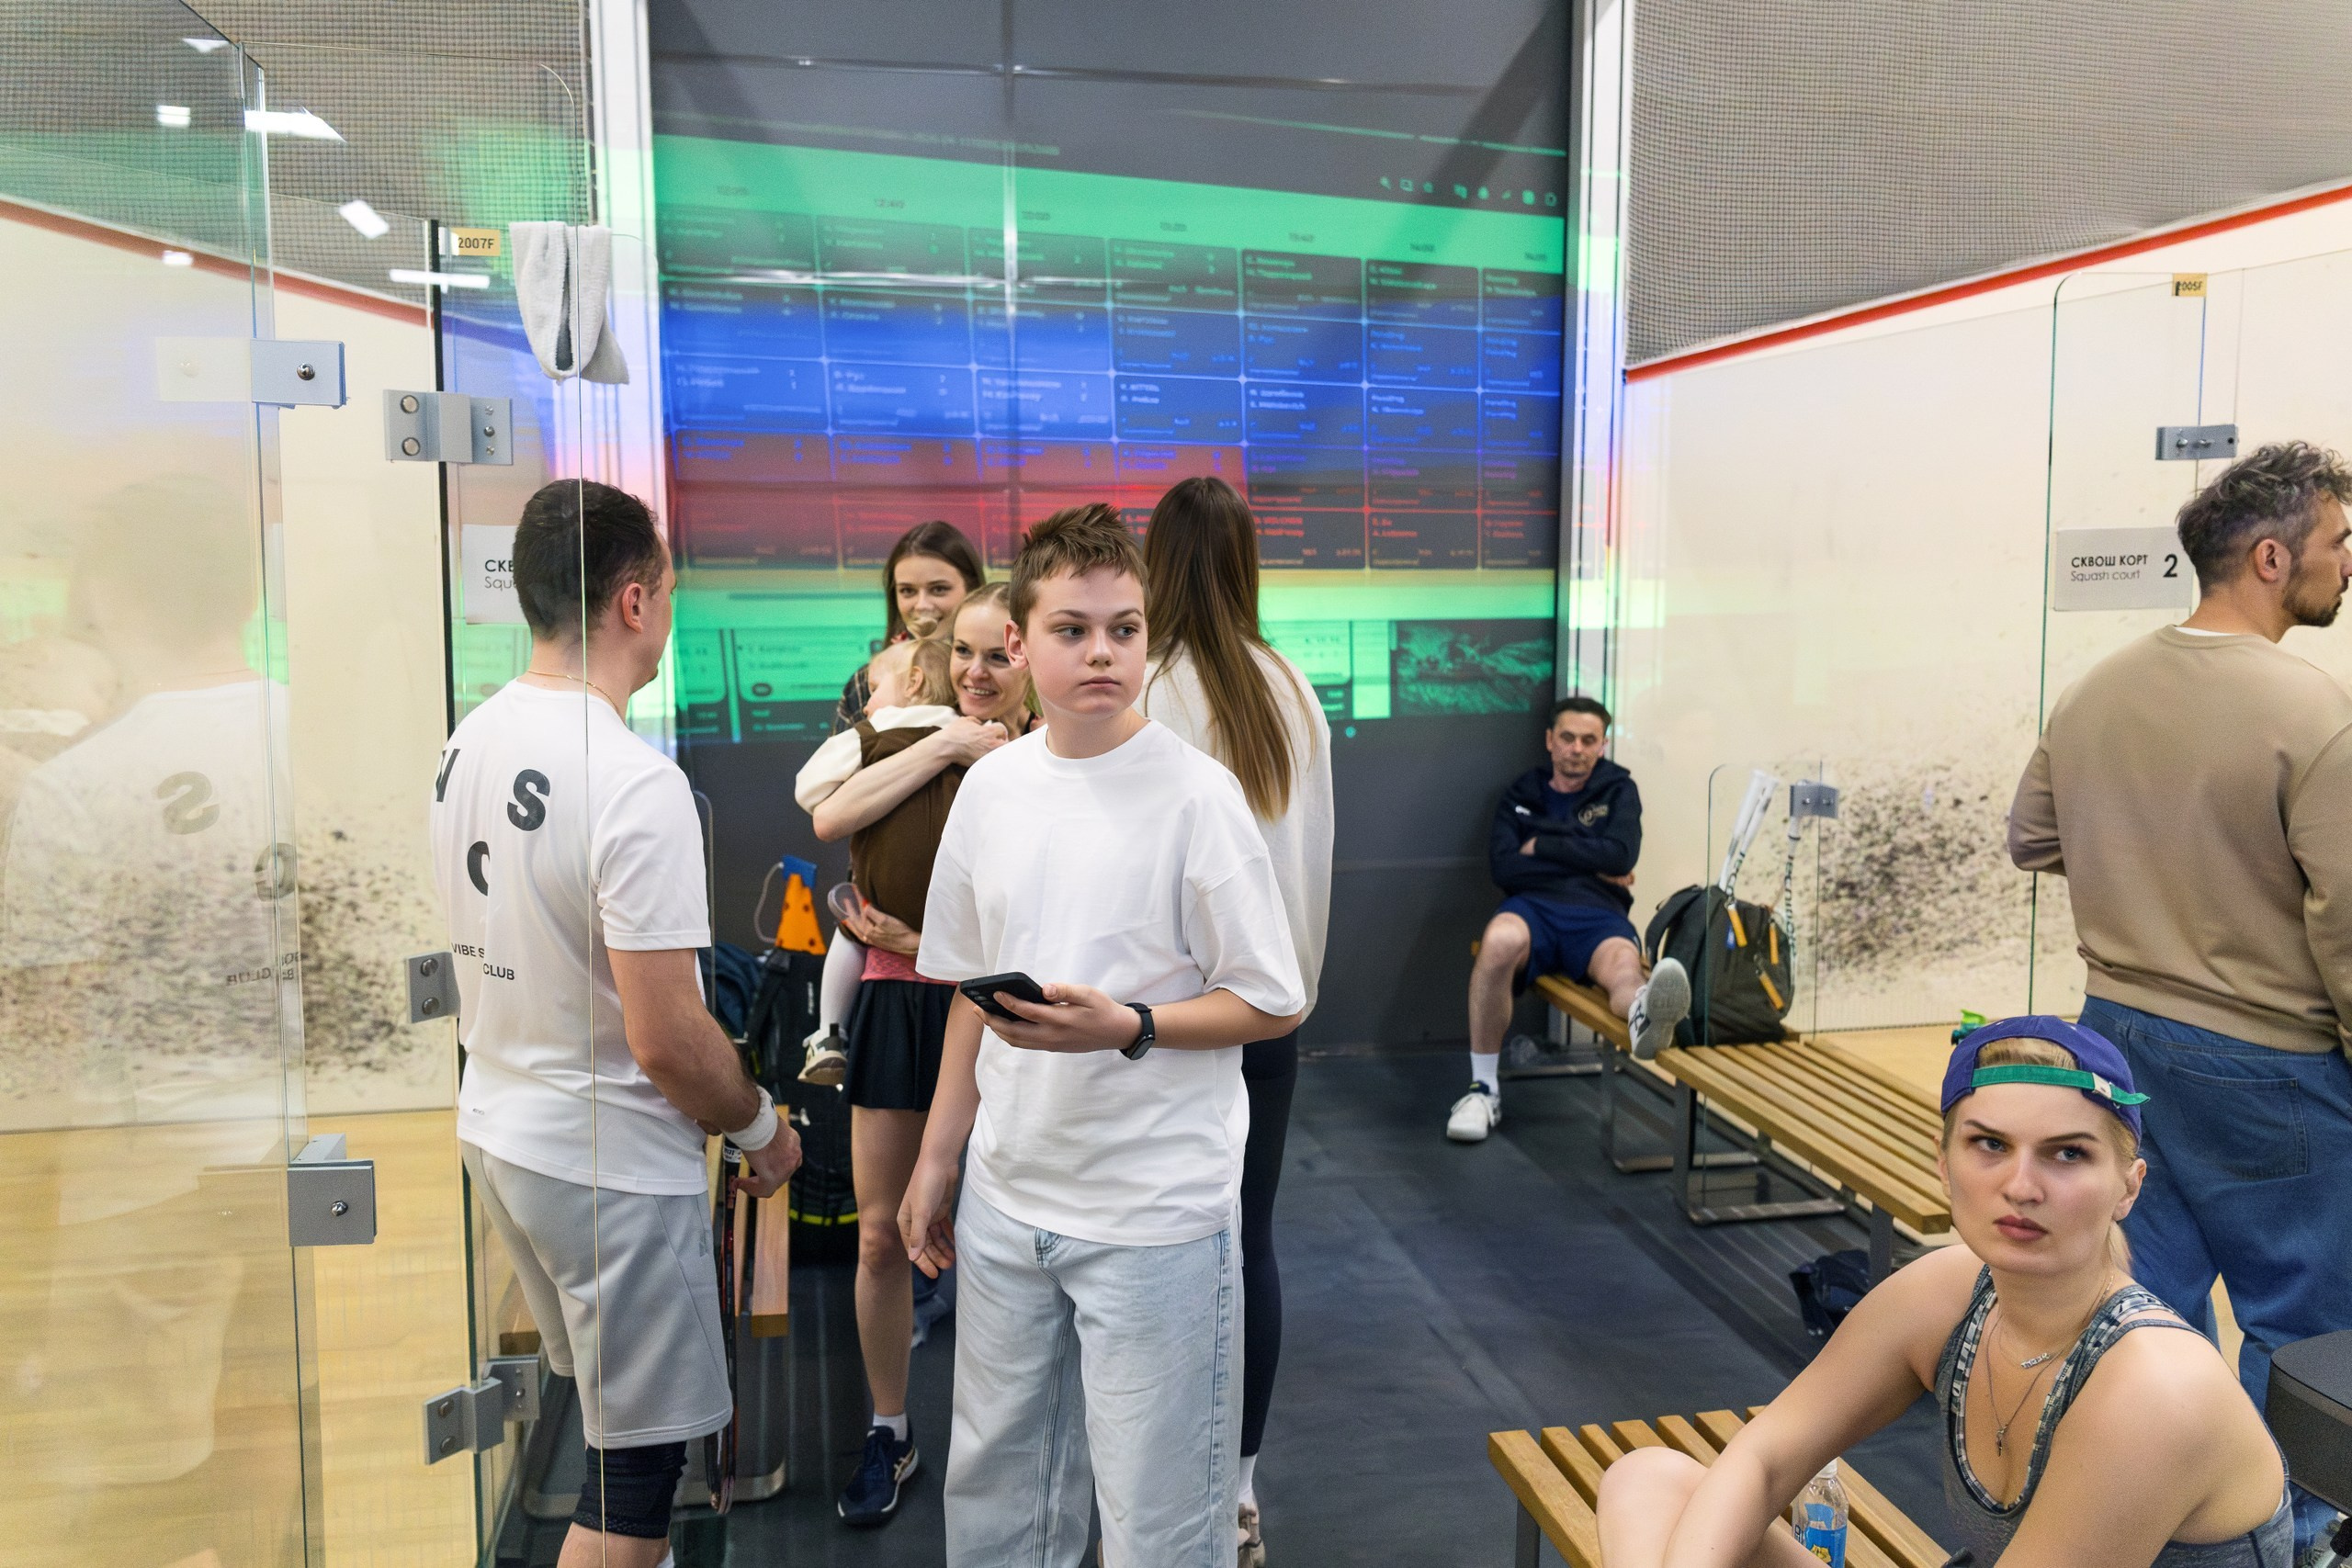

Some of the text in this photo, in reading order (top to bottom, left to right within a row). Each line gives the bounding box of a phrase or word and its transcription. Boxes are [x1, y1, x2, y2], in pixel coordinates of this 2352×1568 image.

[458, 237, 494, 249] 2007F
[2071, 554, 2149, 569] СКВОШ КОРТ
[2163, 553, 2178, 578] 2
[484, 576, 515, 592] Squ
[2070, 570, 2141, 582] Squash court
[507, 769, 551, 831] S
[451, 942, 477, 957] VIBE
[482, 963, 515, 981] CLUB
